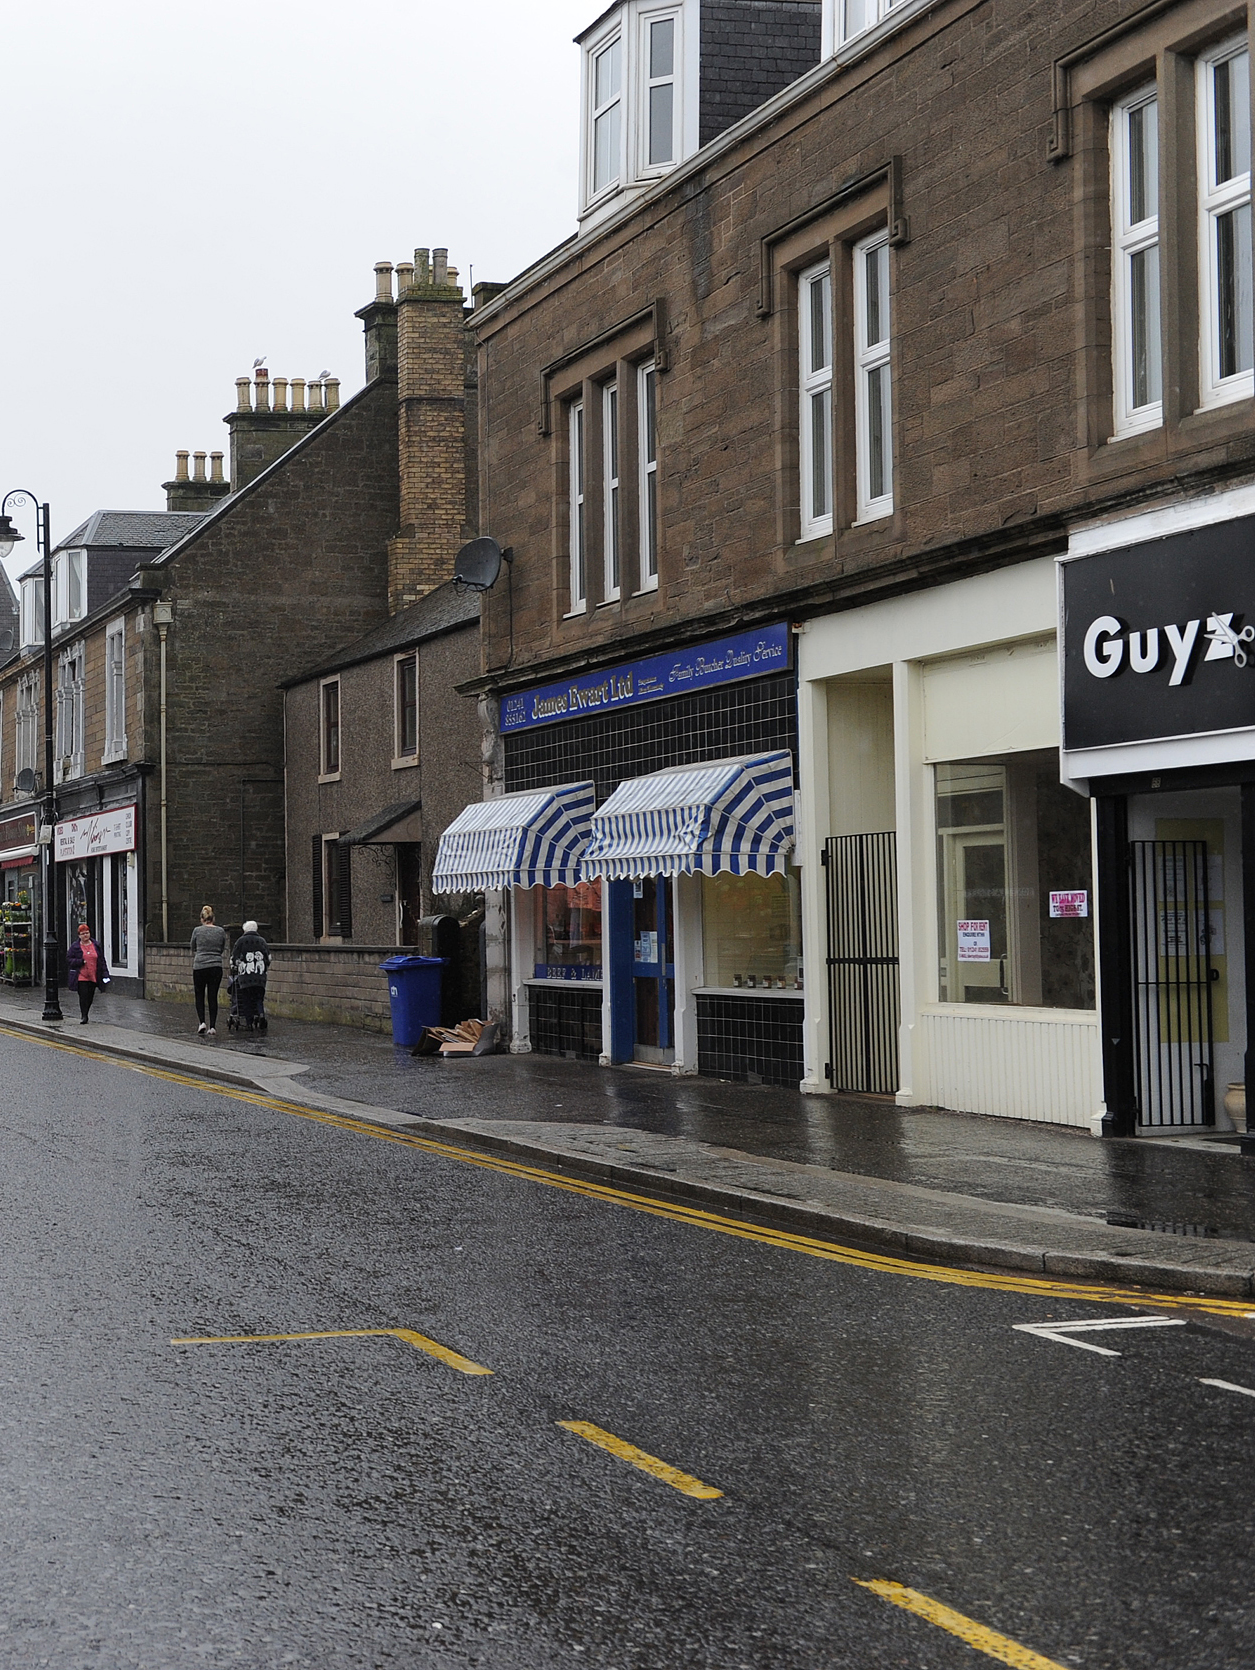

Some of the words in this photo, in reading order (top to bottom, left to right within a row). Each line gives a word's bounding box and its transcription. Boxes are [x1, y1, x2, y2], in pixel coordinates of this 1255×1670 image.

[668, 662, 694, 682] Family
[753, 641, 782, 662] Service
[531, 695, 568, 720] James
[568, 680, 609, 711] Ewart
[610, 671, 634, 701] Ltd
[958, 922, 969, 930] SHOP
[547, 967, 566, 980] BEEF
[570, 968, 576, 980] &
